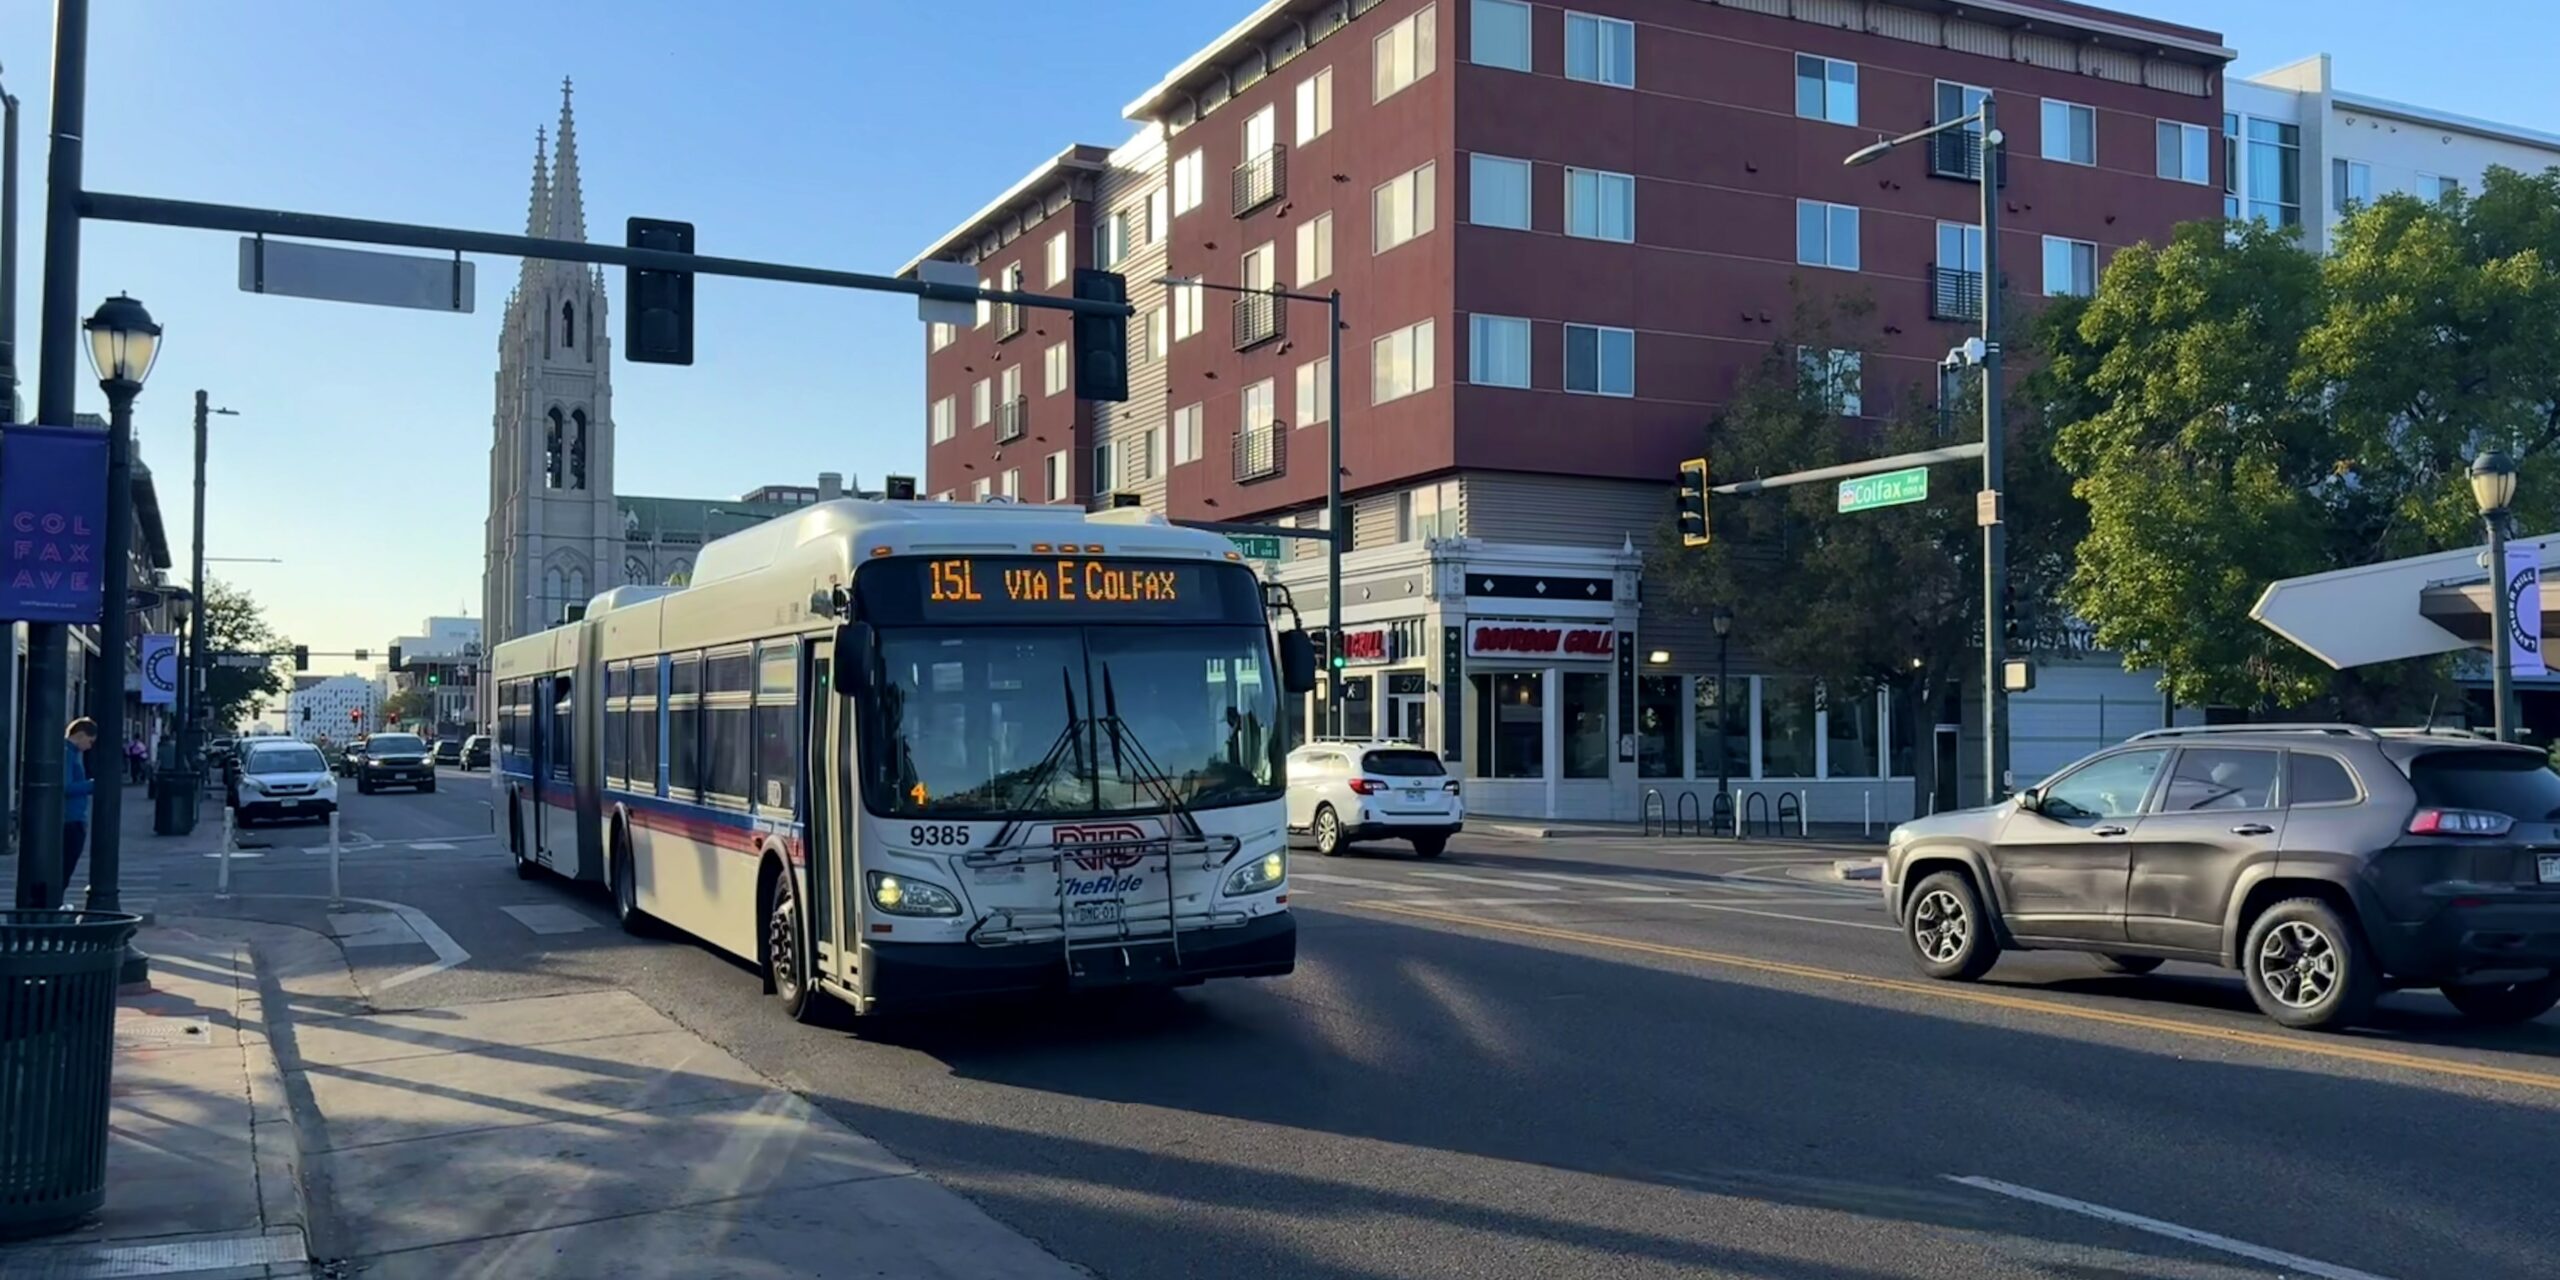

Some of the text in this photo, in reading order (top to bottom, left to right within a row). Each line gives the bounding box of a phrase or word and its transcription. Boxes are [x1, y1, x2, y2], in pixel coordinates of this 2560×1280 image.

[1855, 480, 1902, 504] Colfax
[13, 511, 92, 536] COL
[13, 540, 90, 563] FAX
[1234, 539, 1256, 556] arl
[12, 568, 90, 592] AVE
[929, 559, 982, 601] 15L
[1057, 560, 1076, 601] E
[1563, 629, 1614, 654] GRILL
[910, 782, 927, 805] 4
[910, 825, 970, 846] 9385
[1052, 823, 1146, 872] RTD
